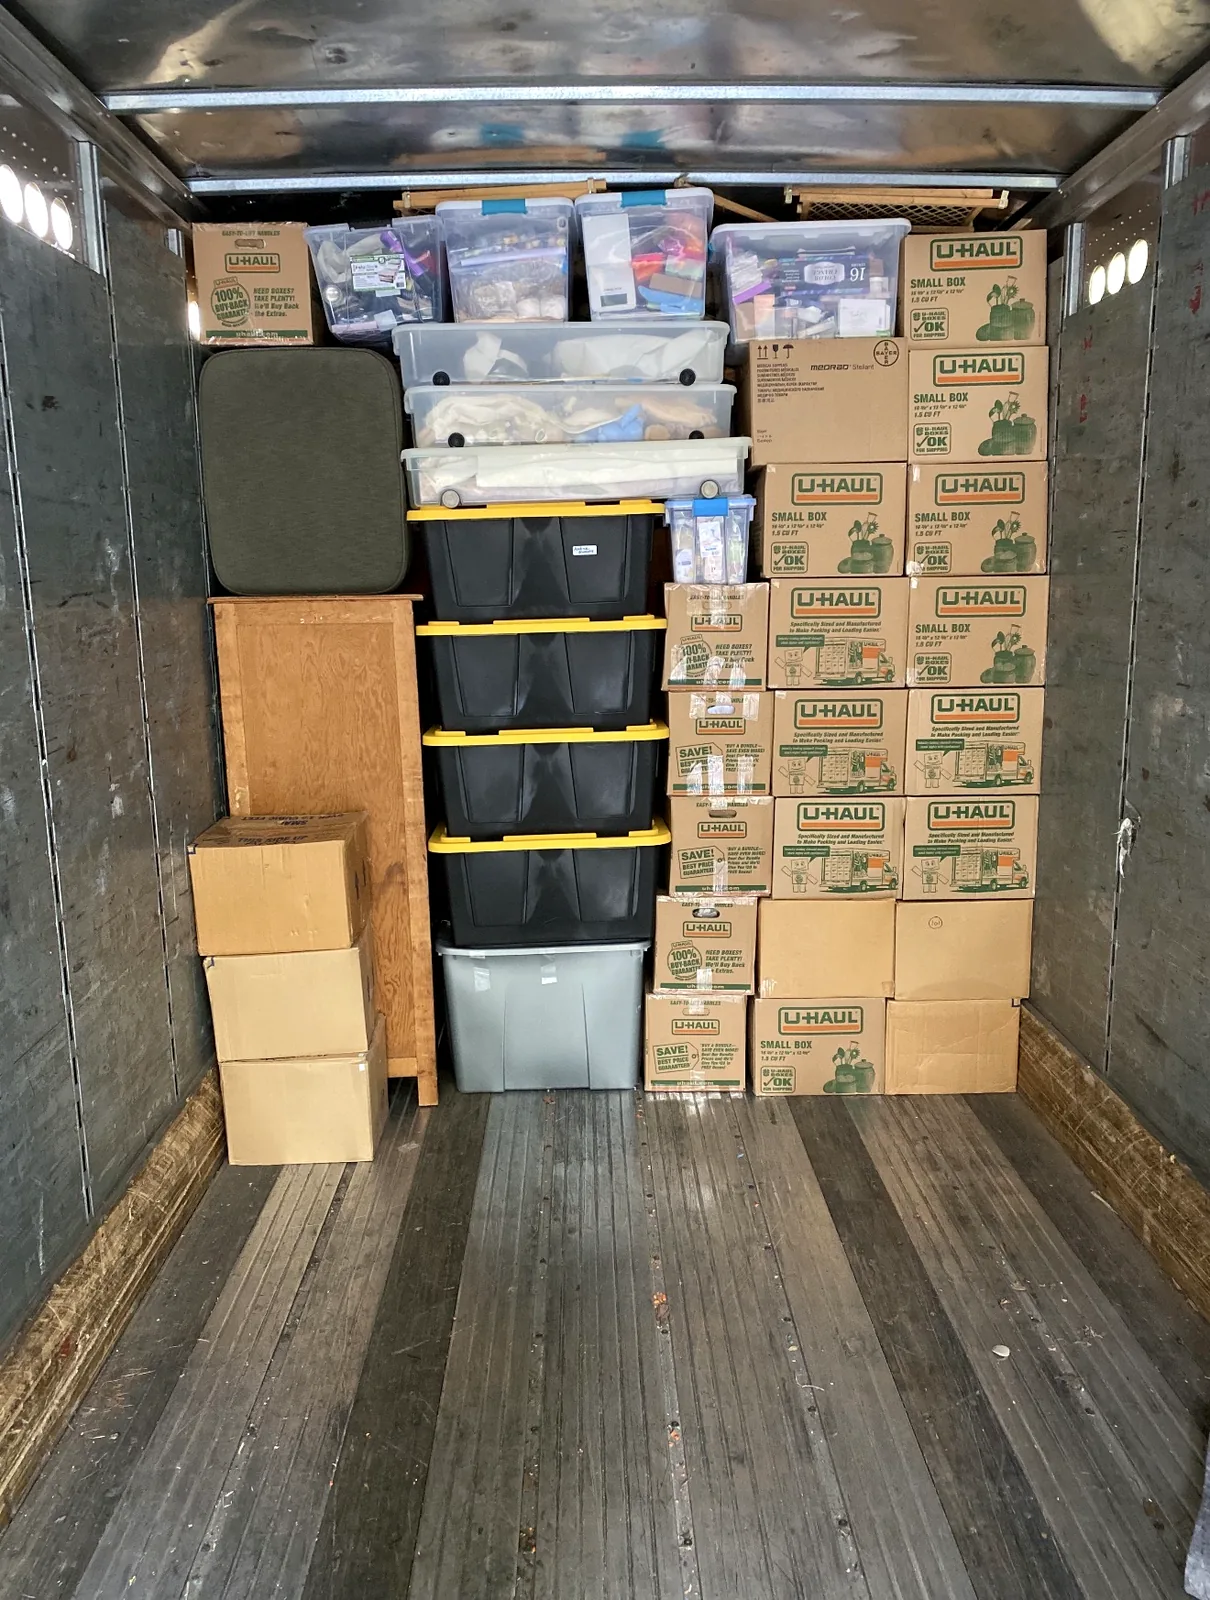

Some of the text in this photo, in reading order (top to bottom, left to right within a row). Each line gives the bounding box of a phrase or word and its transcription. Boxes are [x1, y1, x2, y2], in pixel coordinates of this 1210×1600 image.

[936, 242, 1016, 258] U-HAUL
[229, 256, 276, 265] U-HAUL
[850, 267, 865, 281] 16
[911, 277, 966, 288] SMALL BOX
[215, 287, 243, 302] 100%
[215, 300, 248, 312] BUY-BACK
[924, 322, 944, 332] OK
[940, 358, 1018, 374] U-HAUL
[914, 392, 968, 403] SMALL BOX
[927, 437, 947, 446] OK
[798, 478, 876, 492] U-HAUL
[941, 477, 1019, 493] U-HAUL
[772, 512, 827, 521] SMALL BOX
[915, 512, 970, 522] SMALL BOX
[784, 556, 804, 565] OK
[928, 555, 948, 565] OK
[797, 593, 875, 606] U-HAUL
[942, 591, 1020, 605] U-HAUL
[916, 624, 970, 633] SMALL BOX
[683, 643, 706, 655] 100%
[928, 666, 947, 675] OK
[801, 704, 877, 717] U-HAUL
[938, 698, 1014, 712] U-HAUL
[680, 746, 712, 758] SAVE!
[803, 808, 879, 820] U-HAUL
[934, 806, 1009, 819] U-HAUL
[682, 850, 714, 860] SAVE!
[671, 949, 696, 960] 100%
[670, 960, 700, 968] BUY-BACK
[784, 1011, 857, 1024] U-HAUL
[657, 1046, 688, 1056] SAVE!
[773, 1078, 792, 1086] OK
